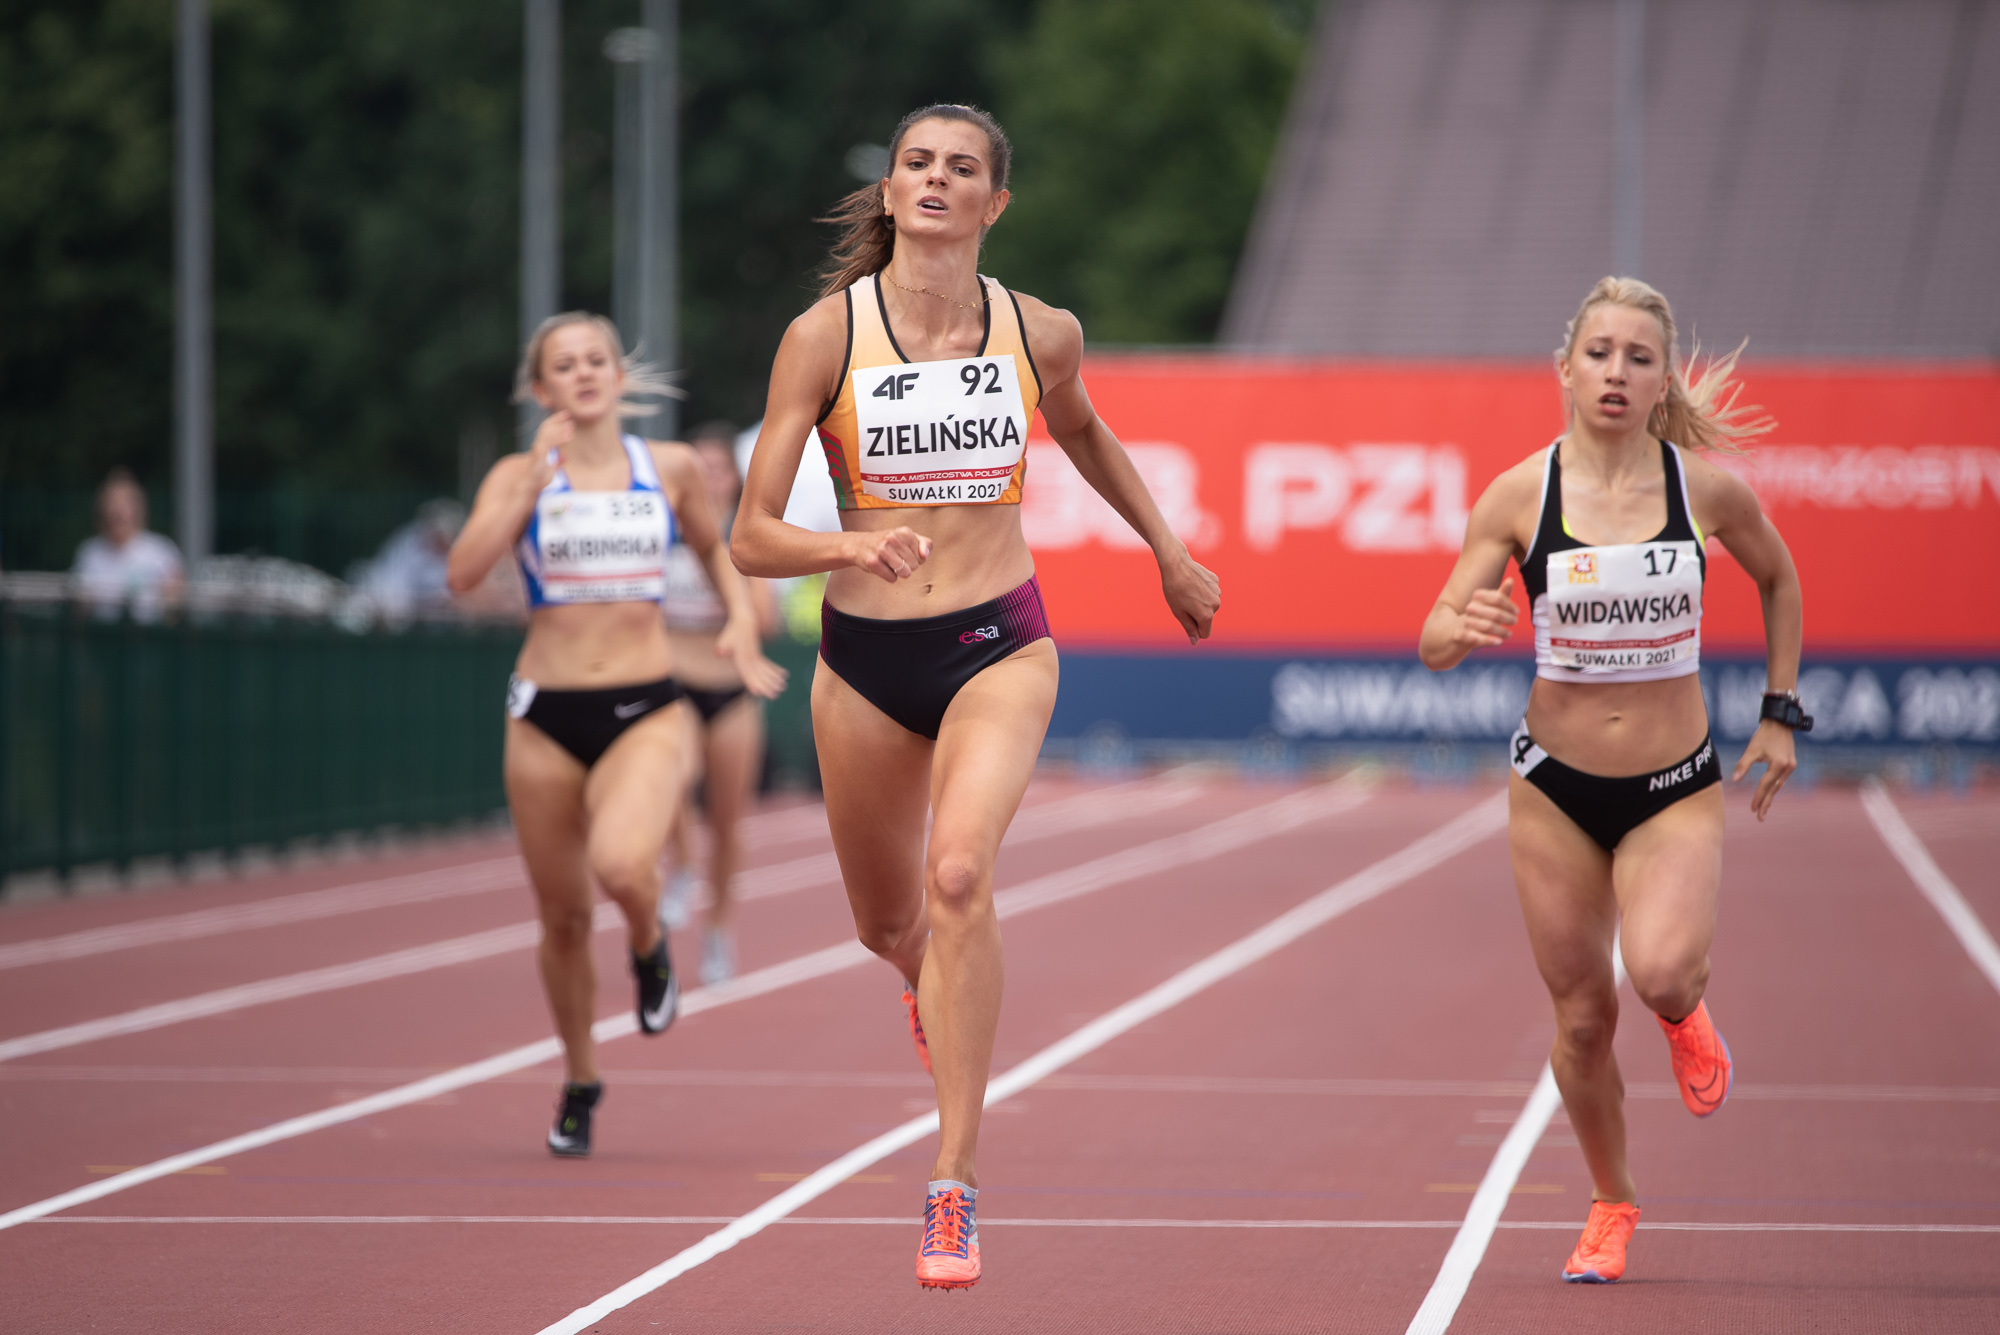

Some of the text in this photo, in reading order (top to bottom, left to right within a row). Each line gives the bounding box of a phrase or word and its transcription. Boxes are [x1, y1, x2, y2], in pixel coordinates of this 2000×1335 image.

[872, 372, 920, 400] 4F
[960, 362, 1002, 396] 92
[867, 414, 1020, 457] ZIELIŃSKA
[888, 483, 1002, 500] SUWAŁKI 2021
[908, 471, 974, 482] MISTRZOSTWA
[1244, 440, 1484, 552] PZL
[1644, 548, 1677, 576] 17
[1556, 593, 1691, 625] WIDAWSKA
[1574, 648, 1676, 666] SUWAŁKI 2021
[1514, 735, 1534, 765] 4
[1649, 762, 1694, 792] NIKE
